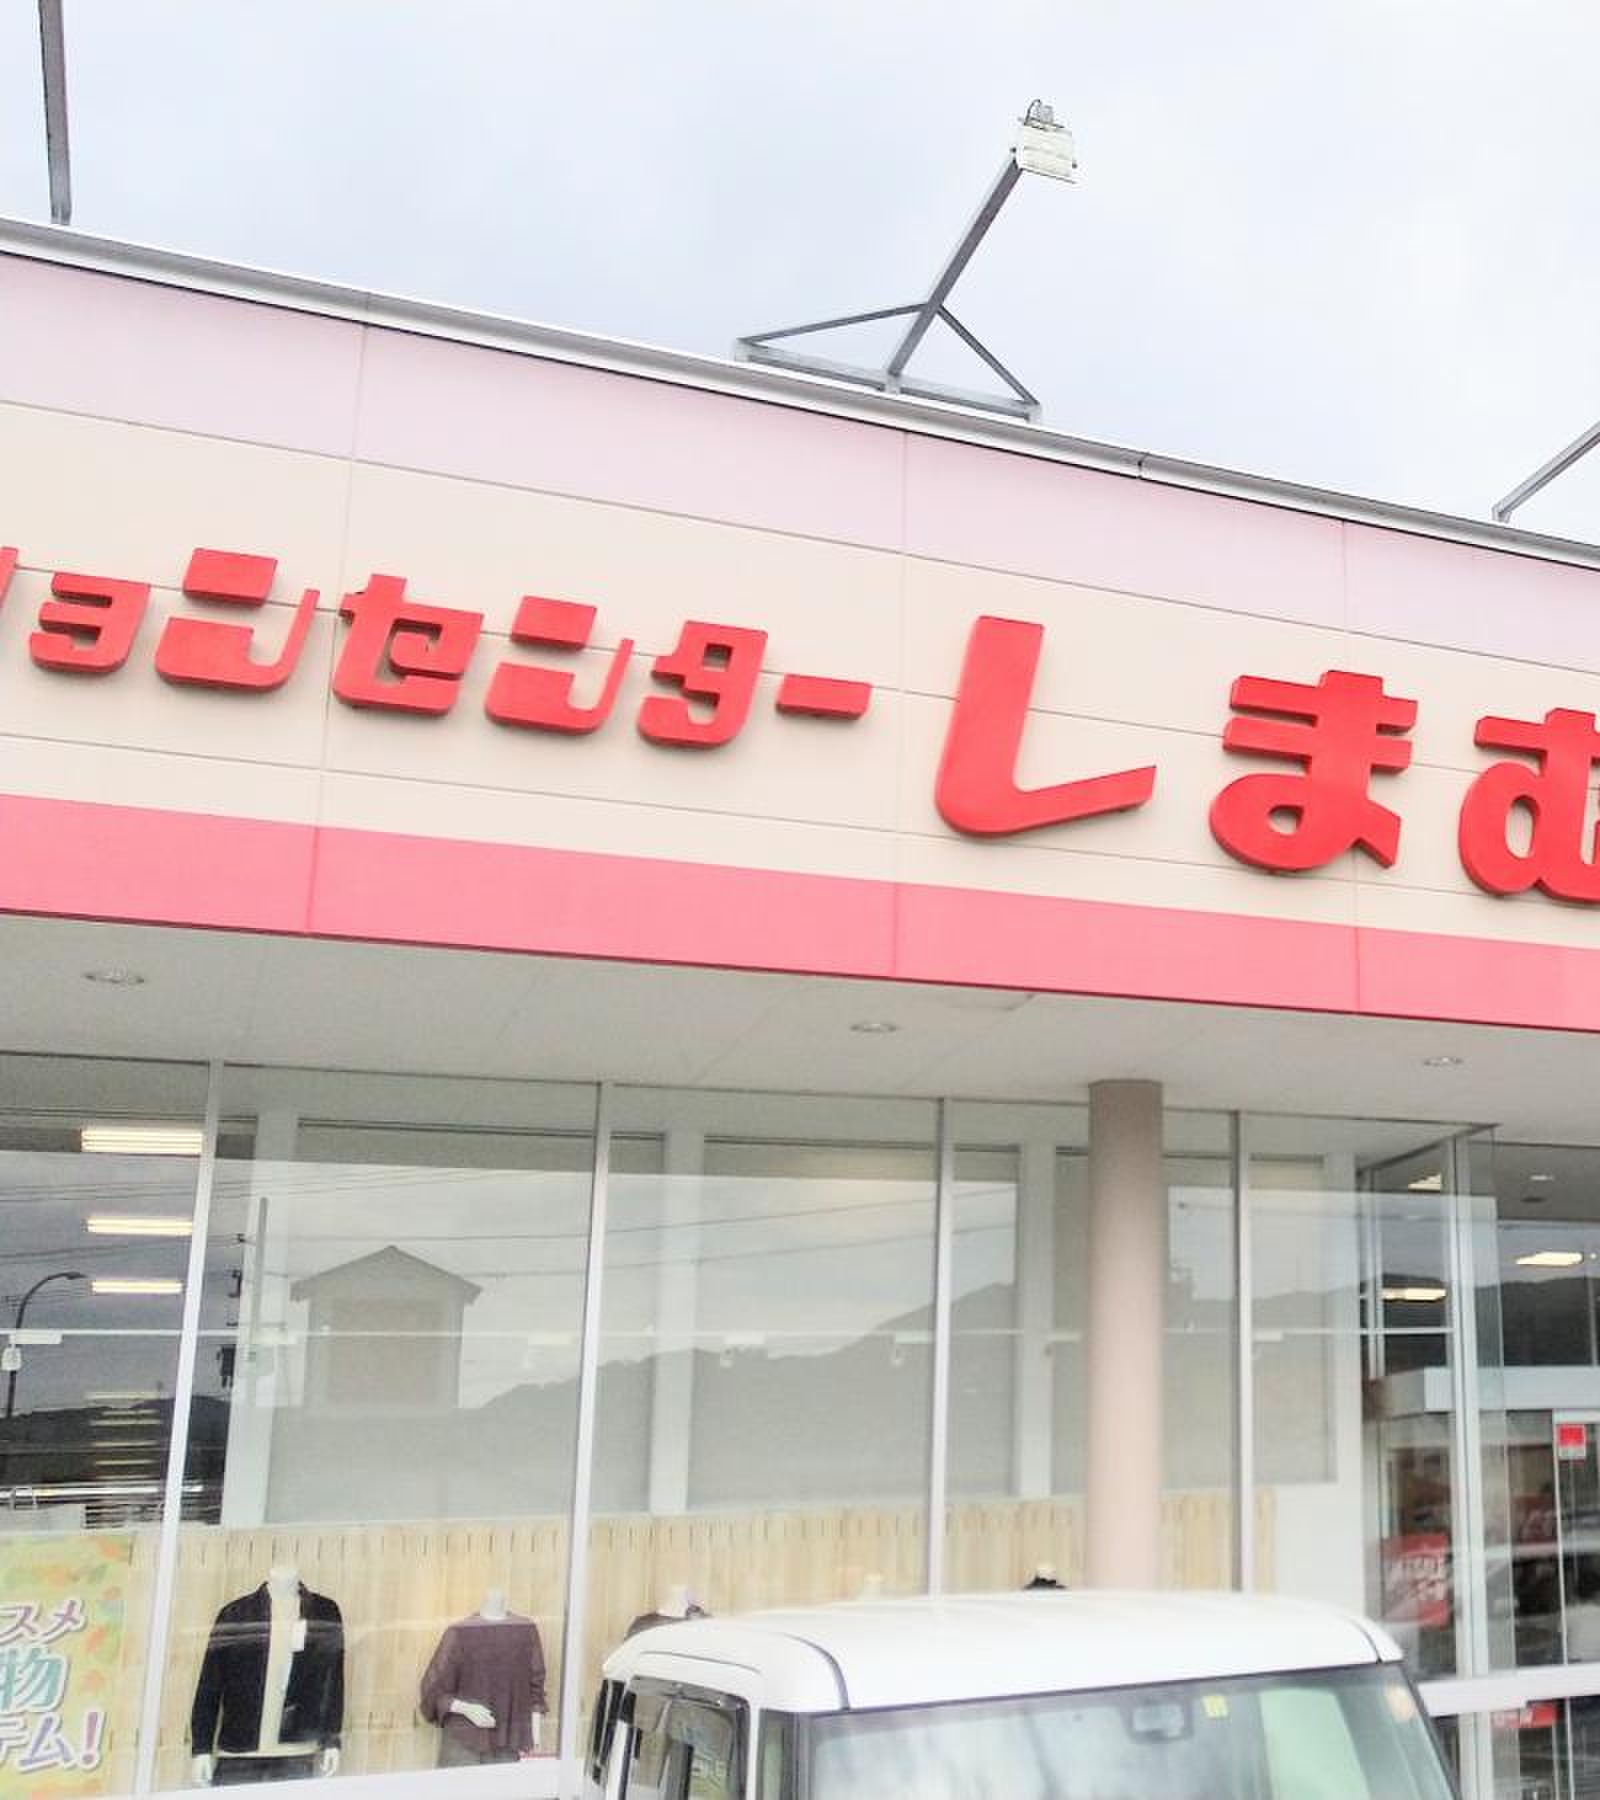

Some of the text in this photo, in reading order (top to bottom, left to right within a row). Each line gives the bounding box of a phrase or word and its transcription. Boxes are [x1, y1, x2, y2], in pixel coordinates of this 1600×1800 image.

[0, 546, 872, 749] ョンセンター
